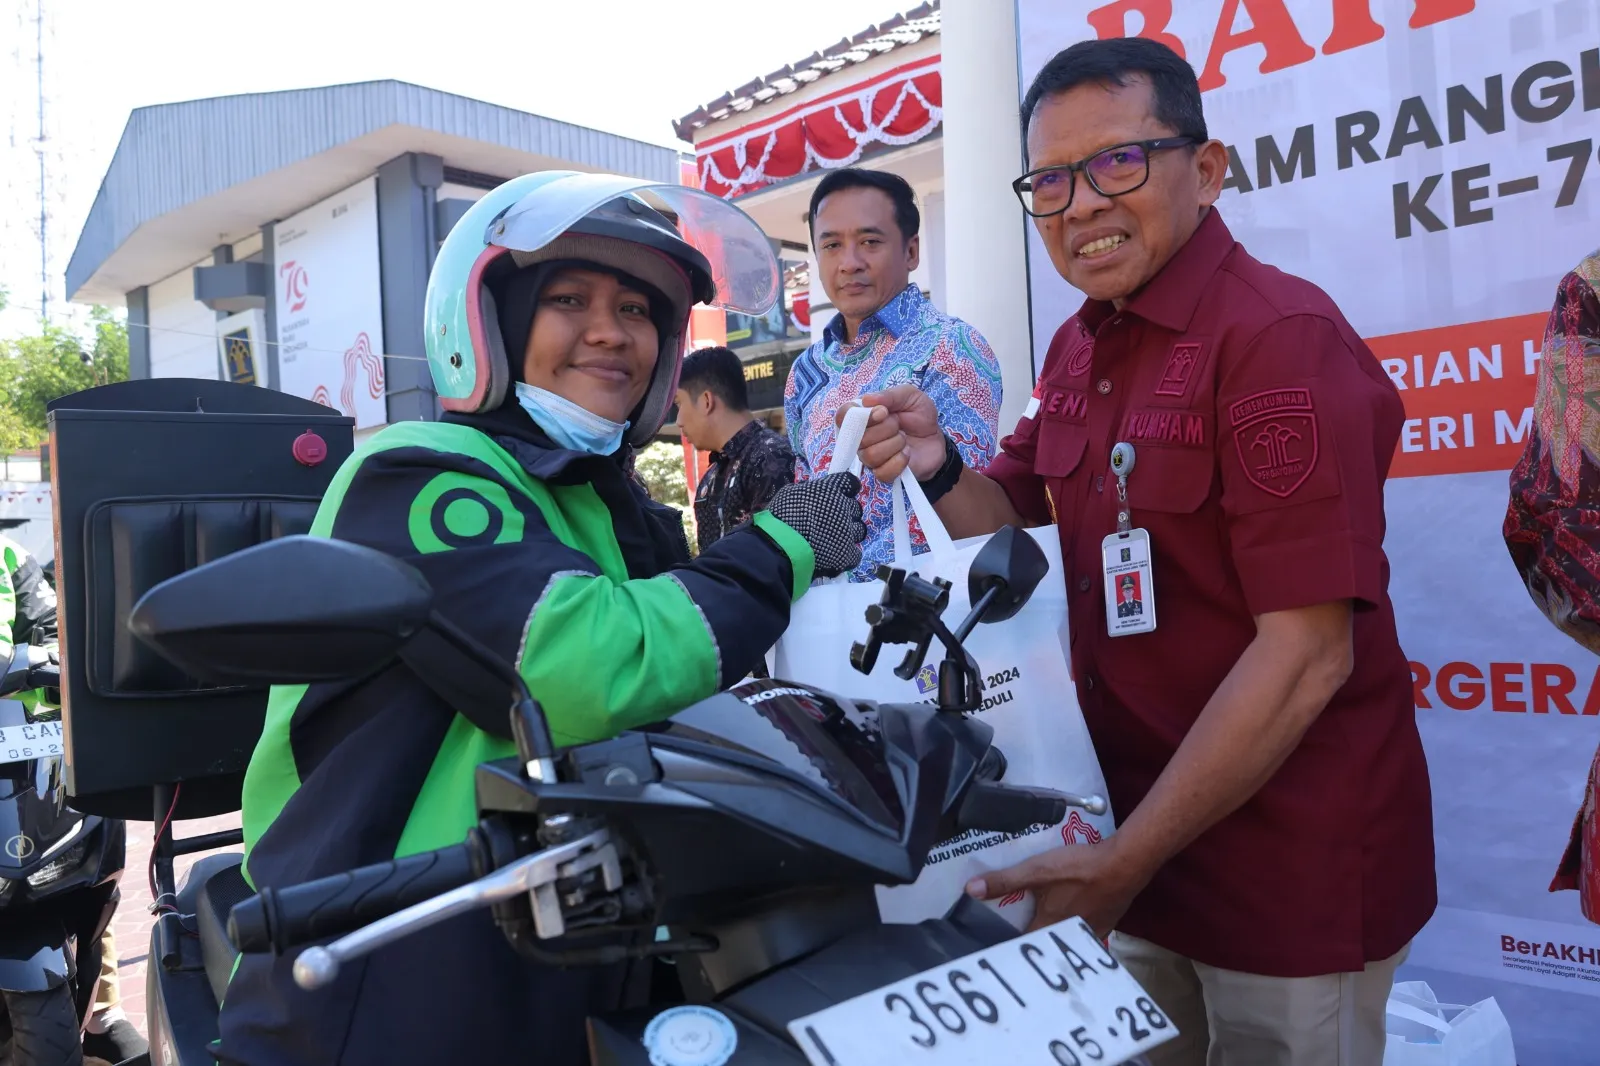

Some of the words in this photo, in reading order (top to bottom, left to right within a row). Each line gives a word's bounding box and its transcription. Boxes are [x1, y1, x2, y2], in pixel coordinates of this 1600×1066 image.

[1129, 412, 1205, 444] KUMHAM
[987, 666, 1021, 689] 2024
[742, 687, 815, 705] HONDA
[951, 832, 1011, 858] INDONESIA
[1501, 935, 1600, 966] BerAKH
[1503, 962, 1533, 972] Harmonis
[1541, 961, 1576, 972] Pelayanan
[884, 957, 1027, 1049] 3661
